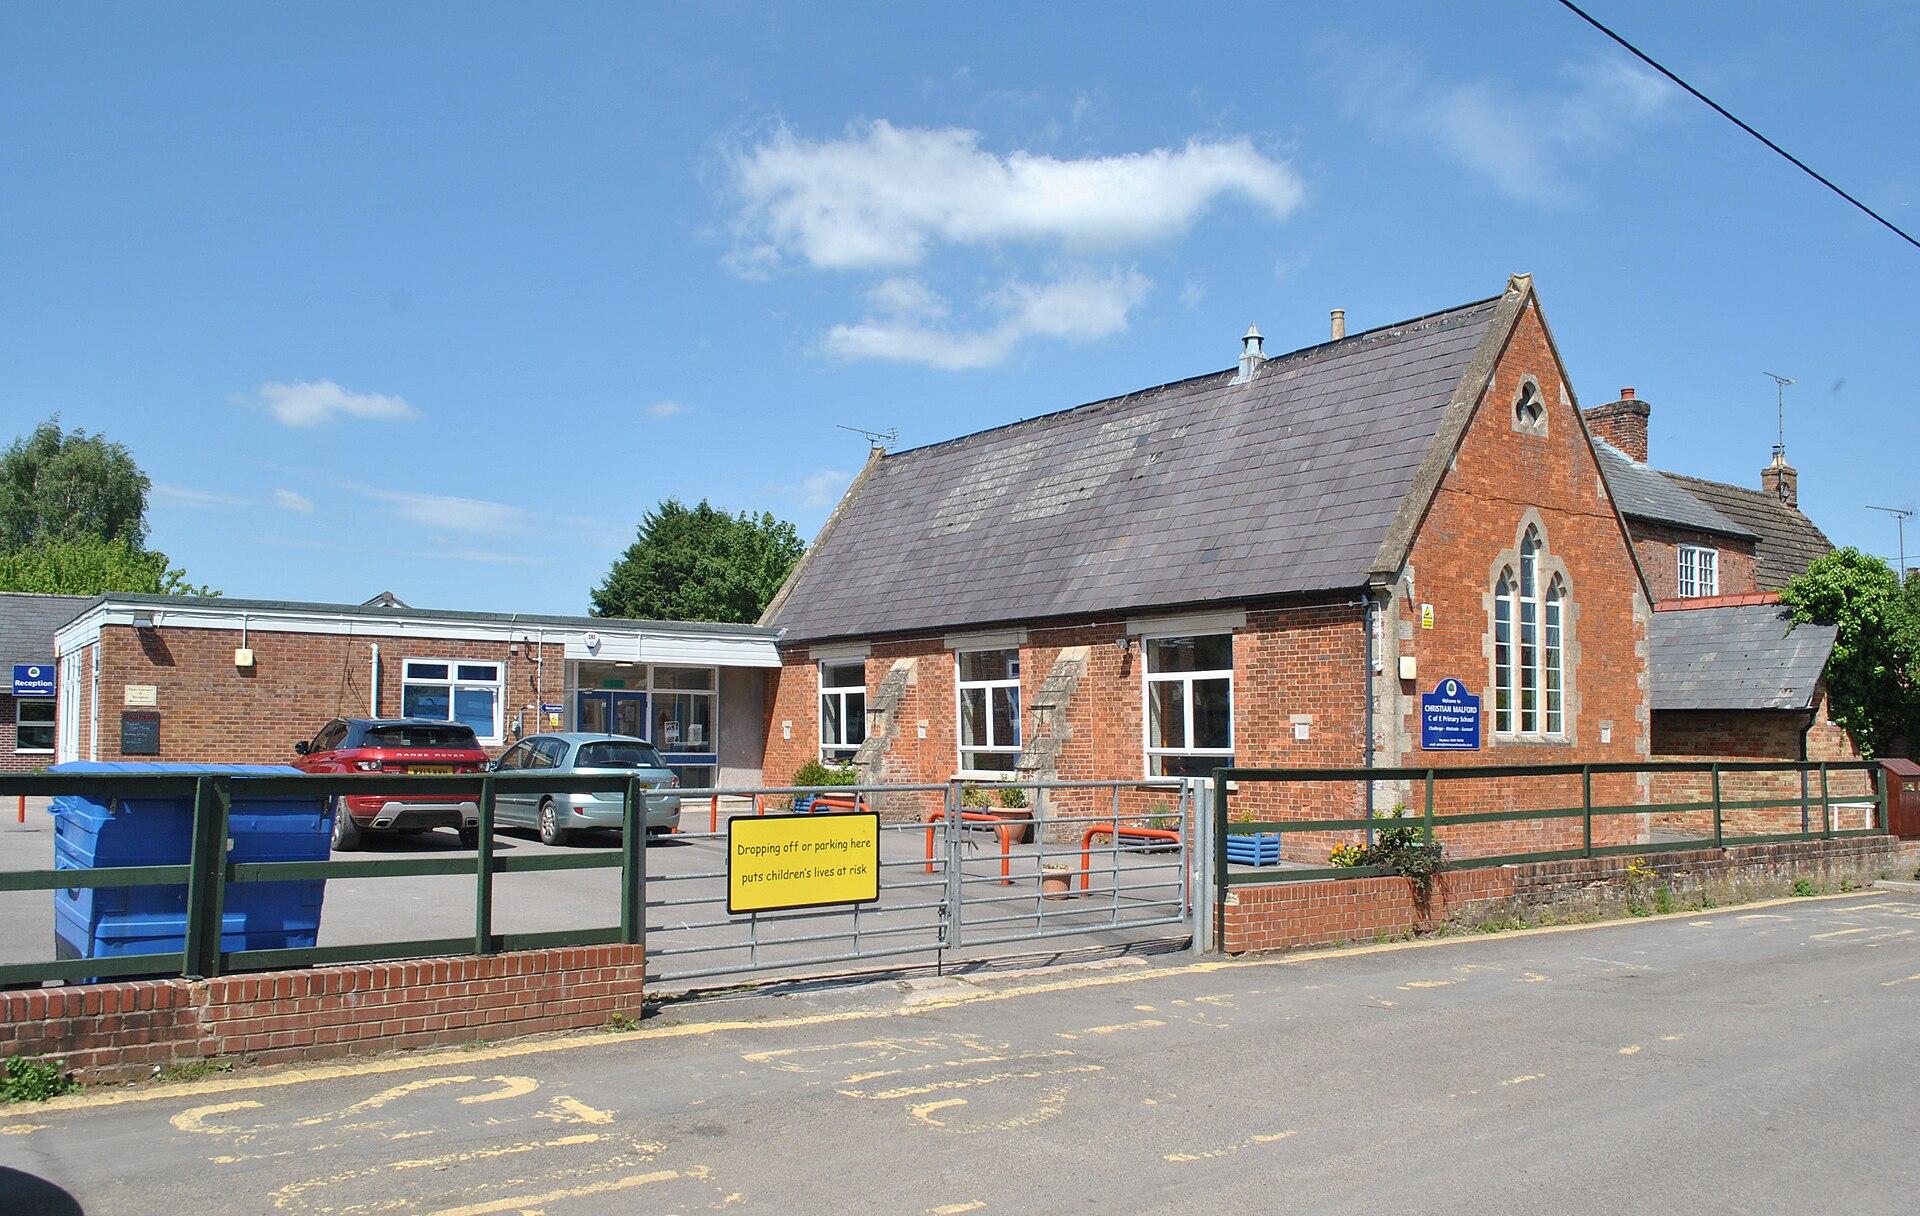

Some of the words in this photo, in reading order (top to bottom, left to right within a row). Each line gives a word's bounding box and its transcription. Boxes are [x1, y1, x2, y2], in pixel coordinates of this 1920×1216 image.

[15, 680, 52, 688] Reception
[738, 844, 780, 857] Dropping
[784, 841, 799, 852] off
[802, 843, 812, 851] or
[815, 839, 848, 853] parking
[851, 838, 871, 848] here
[742, 872, 763, 885] puts
[766, 868, 811, 881] children's
[815, 867, 834, 877] lives
[837, 866, 847, 875] at
[849, 864, 867, 875] risk
